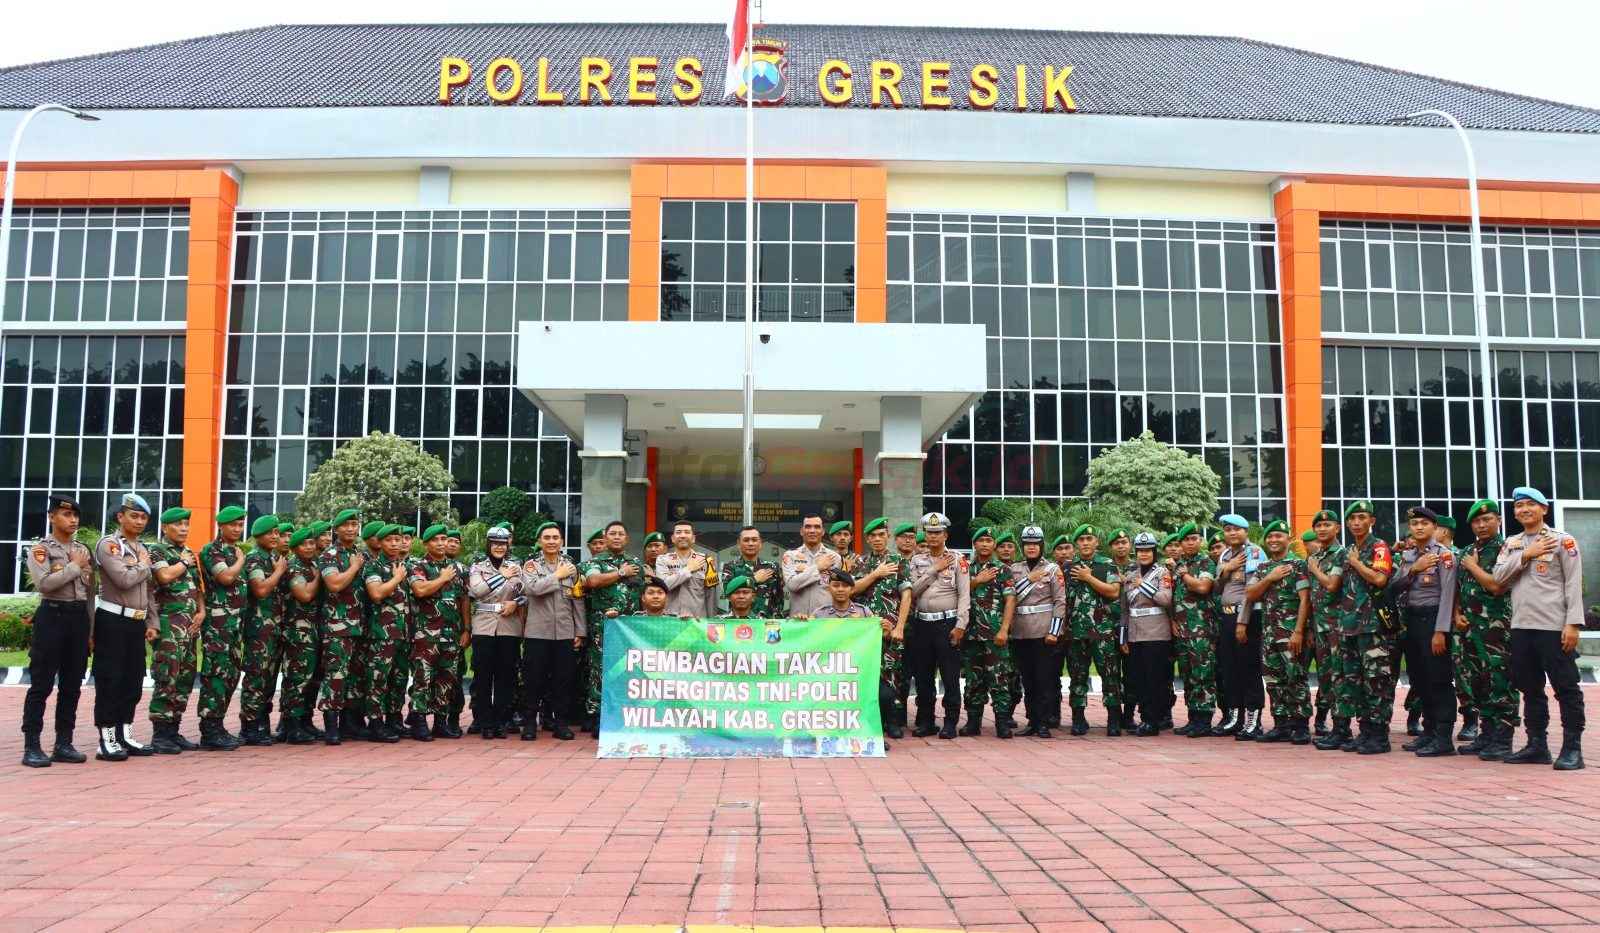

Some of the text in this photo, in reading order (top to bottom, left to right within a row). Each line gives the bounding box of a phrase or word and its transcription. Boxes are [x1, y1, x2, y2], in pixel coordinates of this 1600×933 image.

[439, 56, 1077, 110] POLRES GRESIK
[627, 648, 859, 675] PEMBAGIAN TAKJIL
[627, 678, 859, 702] SINERGITAS TNI-POLRI
[622, 706, 862, 730] WILAYAH KAB. GRESIK
